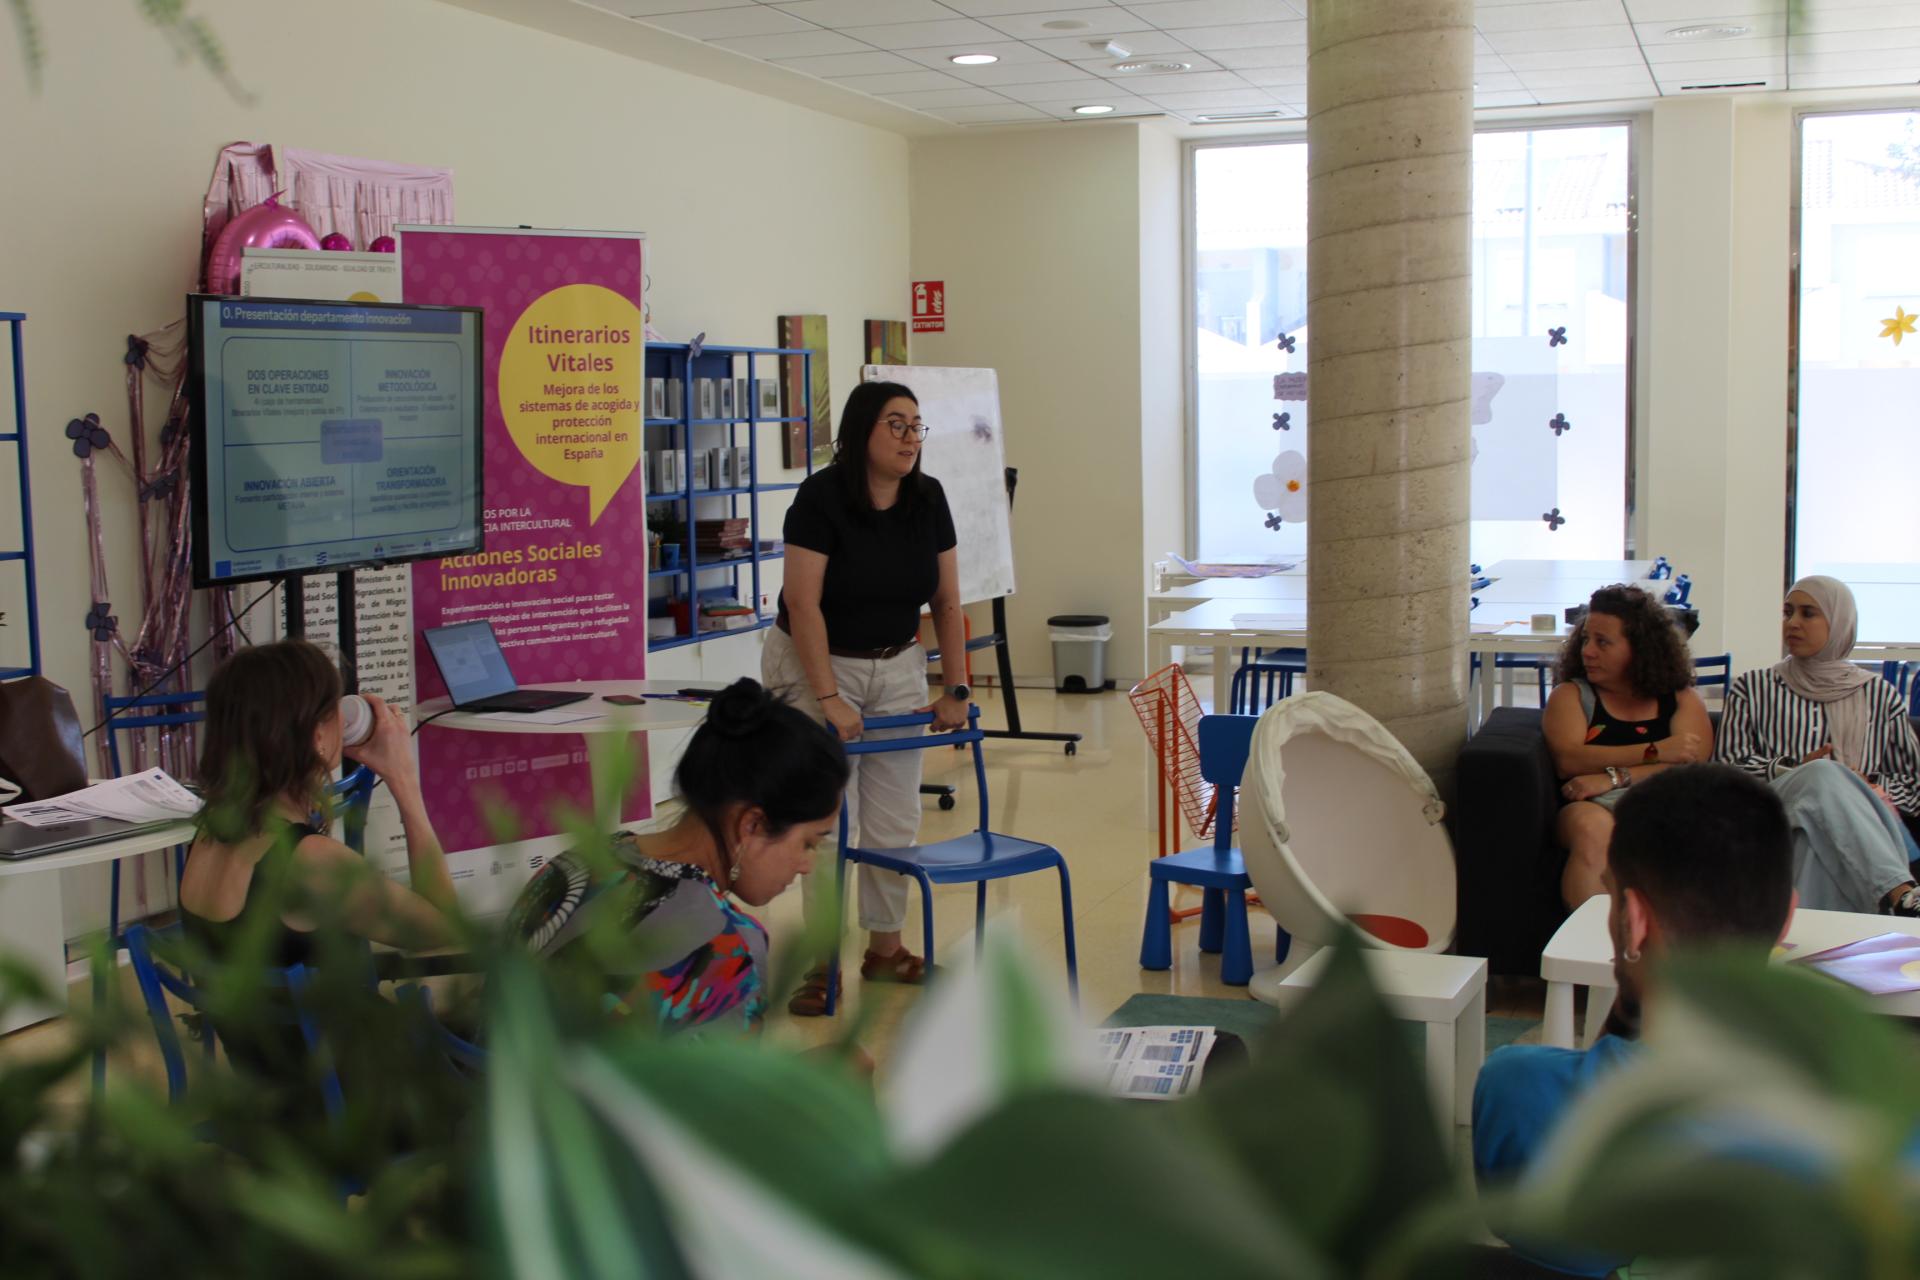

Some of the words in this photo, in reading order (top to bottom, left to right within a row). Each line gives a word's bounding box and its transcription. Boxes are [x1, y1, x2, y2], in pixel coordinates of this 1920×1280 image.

[223, 307, 233, 319] 0.
[235, 308, 300, 321] Presentación
[301, 309, 364, 325] departamento
[366, 312, 411, 324] innovación
[529, 325, 630, 344] Itinerarios
[547, 353, 614, 372] Vitales
[247, 369, 266, 380] DOS
[268, 369, 329, 380] OPERACIONES
[248, 383, 261, 394] EN
[262, 383, 290, 394] CLAVE
[293, 383, 329, 394] ENTIDAD
[378, 380, 437, 392] METODOLÓGICA
[543, 384, 585, 398] Mejora
[588, 383, 600, 394] de
[603, 383, 619, 394] los
[519, 401, 572, 413] sistemas
[575, 400, 589, 411] de
[591, 399, 632, 413] acogida
[634, 401, 640, 412] y
[552, 415, 612, 430] protección
[536, 431, 611, 445] internacional
[614, 433, 628, 442] en
[563, 447, 603, 462] España
[386, 465, 436, 477] ORIENTACIÓN
[244, 478, 298, 491] INNOVACIÓN
[300, 475, 336, 488] ABIERTA
[376, 477, 447, 491] TRANSFORMADORA
[484, 509, 497, 519] OS
[498, 508, 518, 518] POR
[520, 507, 532, 517] LA
[484, 523, 498, 533] CIA
[500, 518, 572, 531] INTERCULTURAL
[440, 549, 523, 570] Acciones
[527, 542, 602, 560] Sociales
[325, 580, 337, 588] po
[356, 575, 391, 583] Ministerio
[441, 567, 557, 592] Innovadoras
[325, 603, 335, 612] de
[442, 602, 504, 615] Experimentación
[512, 597, 551, 608] innovación
[553, 594, 575, 604] social
[576, 595, 593, 604] para
[594, 593, 615, 601] testar
[521, 612, 530, 620] de
[532, 607, 578, 619] intervención
[580, 608, 594, 616] que
[623, 602, 630, 610] la
[319, 617, 338, 626] Gene
[360, 611, 391, 620] Atención
[356, 624, 382, 635] cogida
[389, 622, 399, 630] de
[495, 627, 506, 636] las
[507, 624, 541, 636] personas
[542, 621, 579, 632] migrantes
[594, 616, 630, 626] refugiadas
[526, 635, 571, 645] comunitaria
[381, 647, 408, 656] Interna
[397, 658, 408, 666] dic
[398, 683, 409, 691] act
